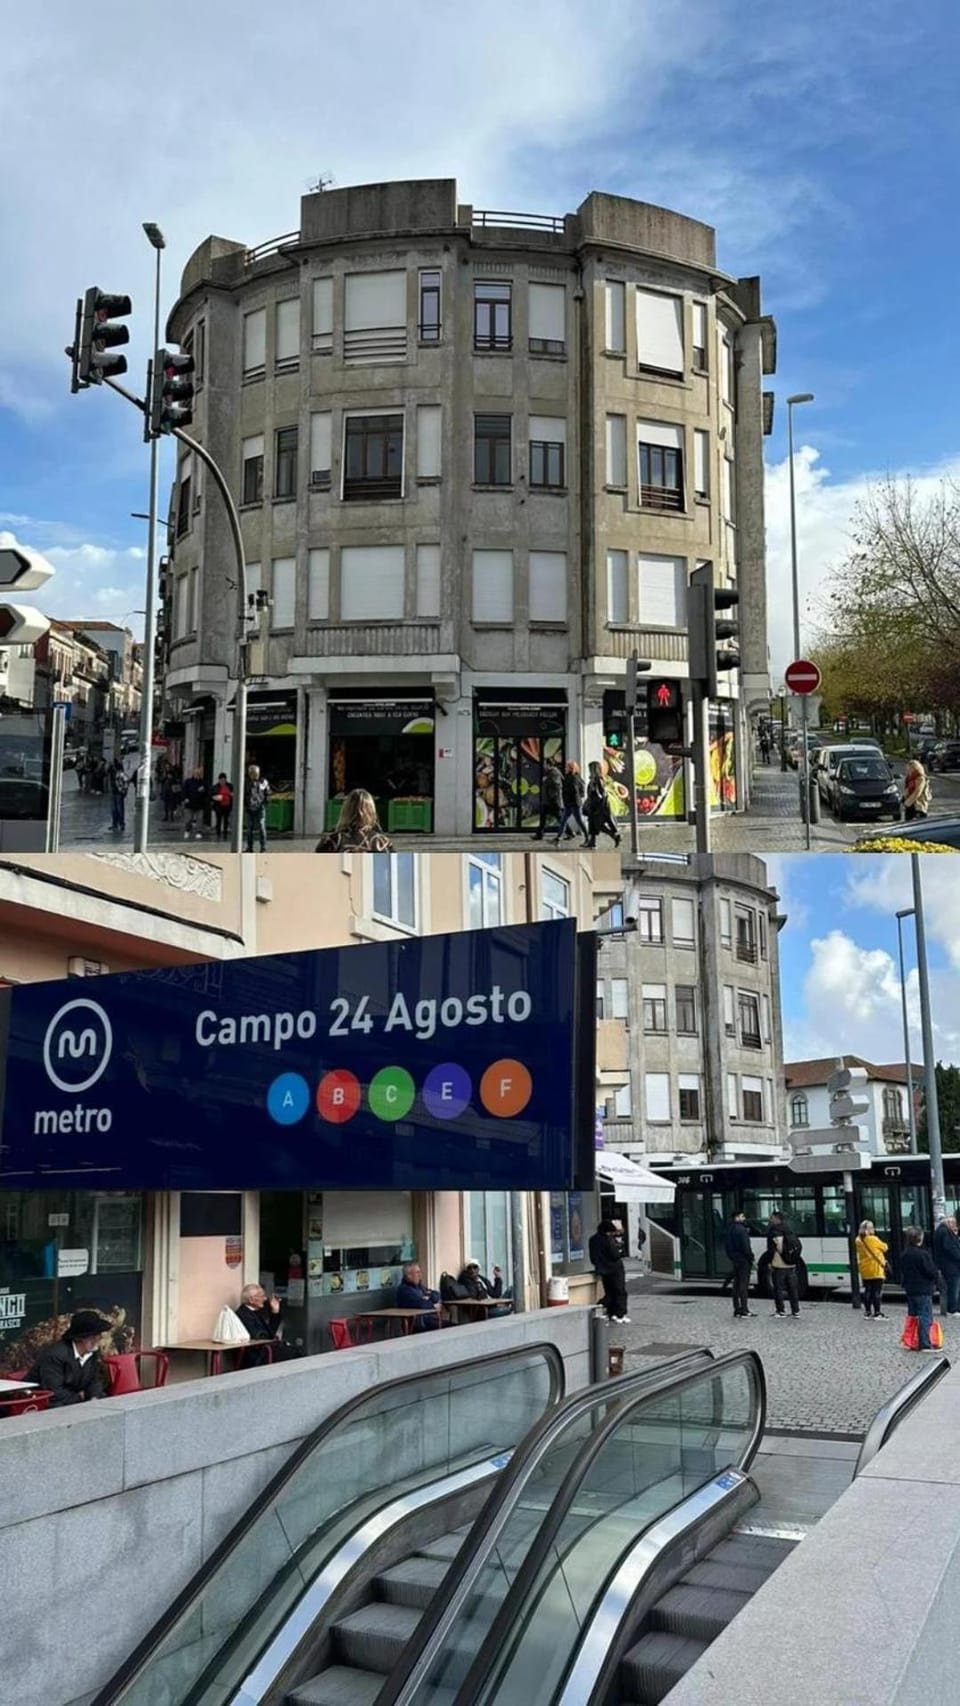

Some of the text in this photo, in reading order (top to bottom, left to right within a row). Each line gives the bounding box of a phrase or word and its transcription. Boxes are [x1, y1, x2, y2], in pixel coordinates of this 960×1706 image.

[195, 985, 532, 1051] Campo 24 Agosto
[282, 1078, 513, 1108] A B C E F
[34, 1103, 113, 1135] metro
